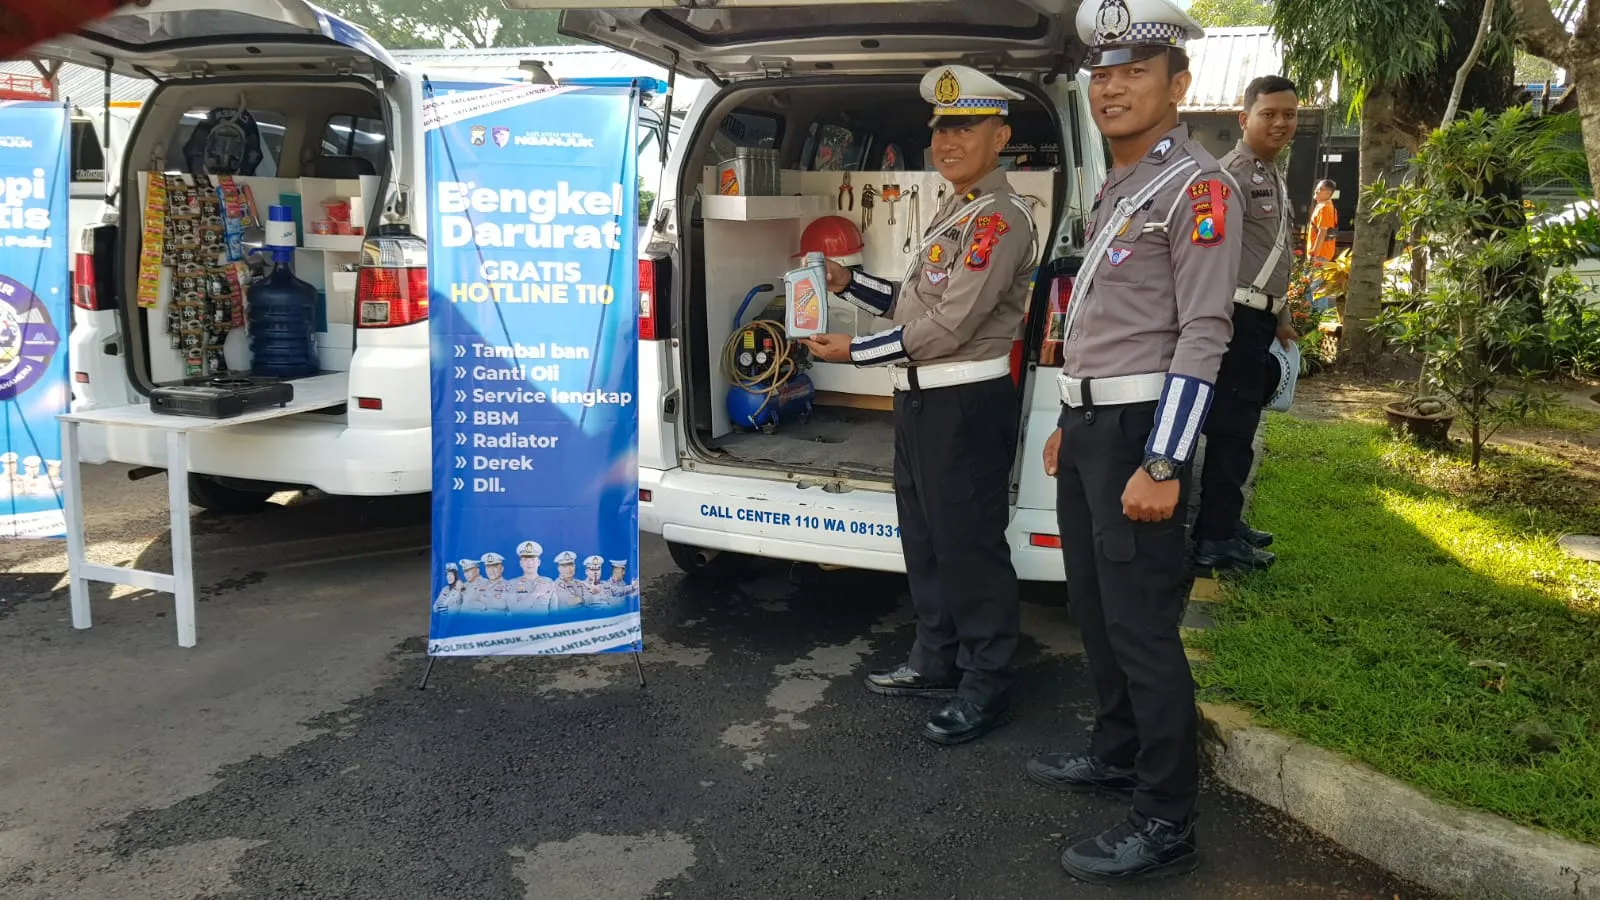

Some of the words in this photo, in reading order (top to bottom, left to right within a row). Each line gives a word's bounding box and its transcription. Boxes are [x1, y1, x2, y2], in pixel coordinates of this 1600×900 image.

[514, 136, 594, 148] NGANJUK
[0, 168, 45, 208] pi
[437, 181, 623, 224] Bengkel
[440, 215, 622, 250] Darurat
[479, 259, 582, 283] GRATIS
[451, 282, 569, 304] HOTLINE
[576, 285, 614, 305] 110
[472, 343, 545, 359] Tambal
[551, 344, 589, 360] ban
[473, 365, 526, 381] Ganti
[531, 364, 560, 382] Oli
[473, 388, 545, 404] Service
[552, 388, 632, 407] lengkap
[473, 411, 519, 425] BBM
[473, 432, 559, 449] Radiator
[473, 455, 534, 471] Derek
[473, 477, 506, 493] Dll.
[700, 504, 733, 519] CALL
[737, 508, 791, 526] CENTER
[795, 515, 819, 529] 110
[824, 518, 846, 533] WA
[437, 642, 475, 653] POLRES
[529, 628, 585, 642] SATLANTAS
[592, 629, 627, 644] POLRES
